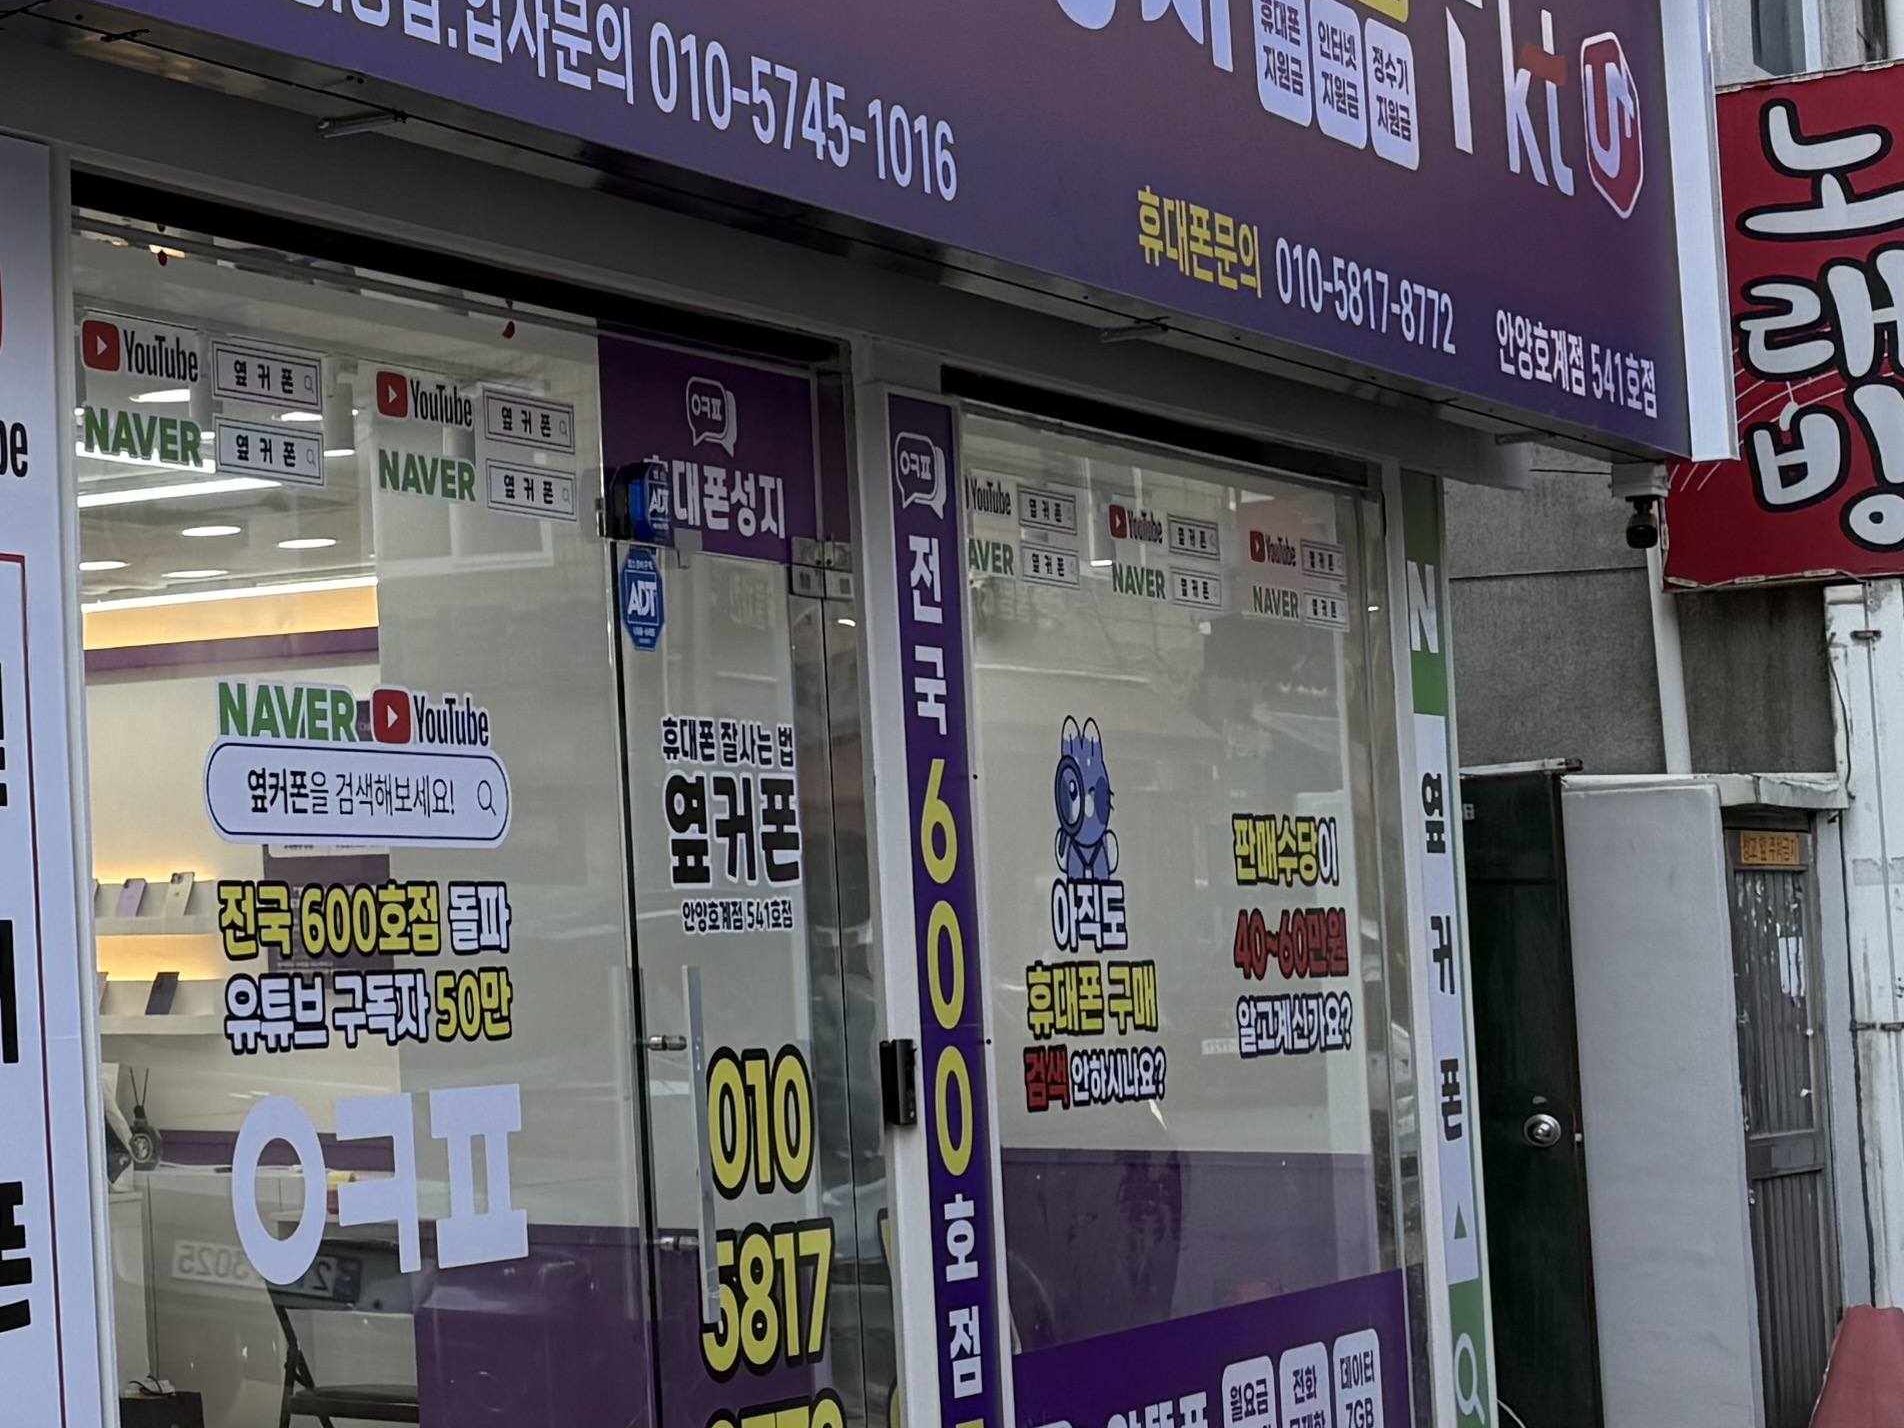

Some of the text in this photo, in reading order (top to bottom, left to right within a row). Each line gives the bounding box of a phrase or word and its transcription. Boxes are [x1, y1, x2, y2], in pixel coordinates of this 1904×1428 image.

[649, 21, 957, 201] 010-5745-1016
[1137, 185, 1456, 355] 휴대폰문의 010-5817-8772
[124, 330, 198, 383] YouTube
[1496, 309, 1657, 419] 안양호계점 541호점
[84, 406, 202, 467] NAVER
[411, 379, 473, 428] YouTube
[379, 449, 475, 502] NAVER
[1112, 563, 1166, 600] NAVER
[1253, 586, 1299, 619] NAVER
[1407, 560, 1439, 655] N
[908, 535, 947, 735] 전국
[218, 680, 356, 743] NAVER
[413, 693, 489, 748] YouTube
[248, 767, 455, 818] 옆커폰을 검색해보세요!
[666, 775, 800, 883] 옆커폰
[1233, 815, 1339, 885] 판매수당이
[219, 882, 509, 957] 전국 600호점 돌파
[1053, 882, 1127, 950] 아직도
[1235, 909, 1349, 979] 40~60만원
[1421, 771, 1463, 1141] 옆커폰
[226, 968, 511, 1052] 유튜브 구독자 50만
[1028, 961, 1157, 1036] 휴대폰 구매
[1238, 993, 1352, 1057] 알고계신가요?
[1025, 1047, 1165, 1111] 검색 안하시나요?
[707, 1052, 810, 1193] 010
[1229, 1378, 1269, 1423] 월요금
[1293, 1366, 1317, 1406] 전화
[1340, 1349, 1374, 1390] 데이터
